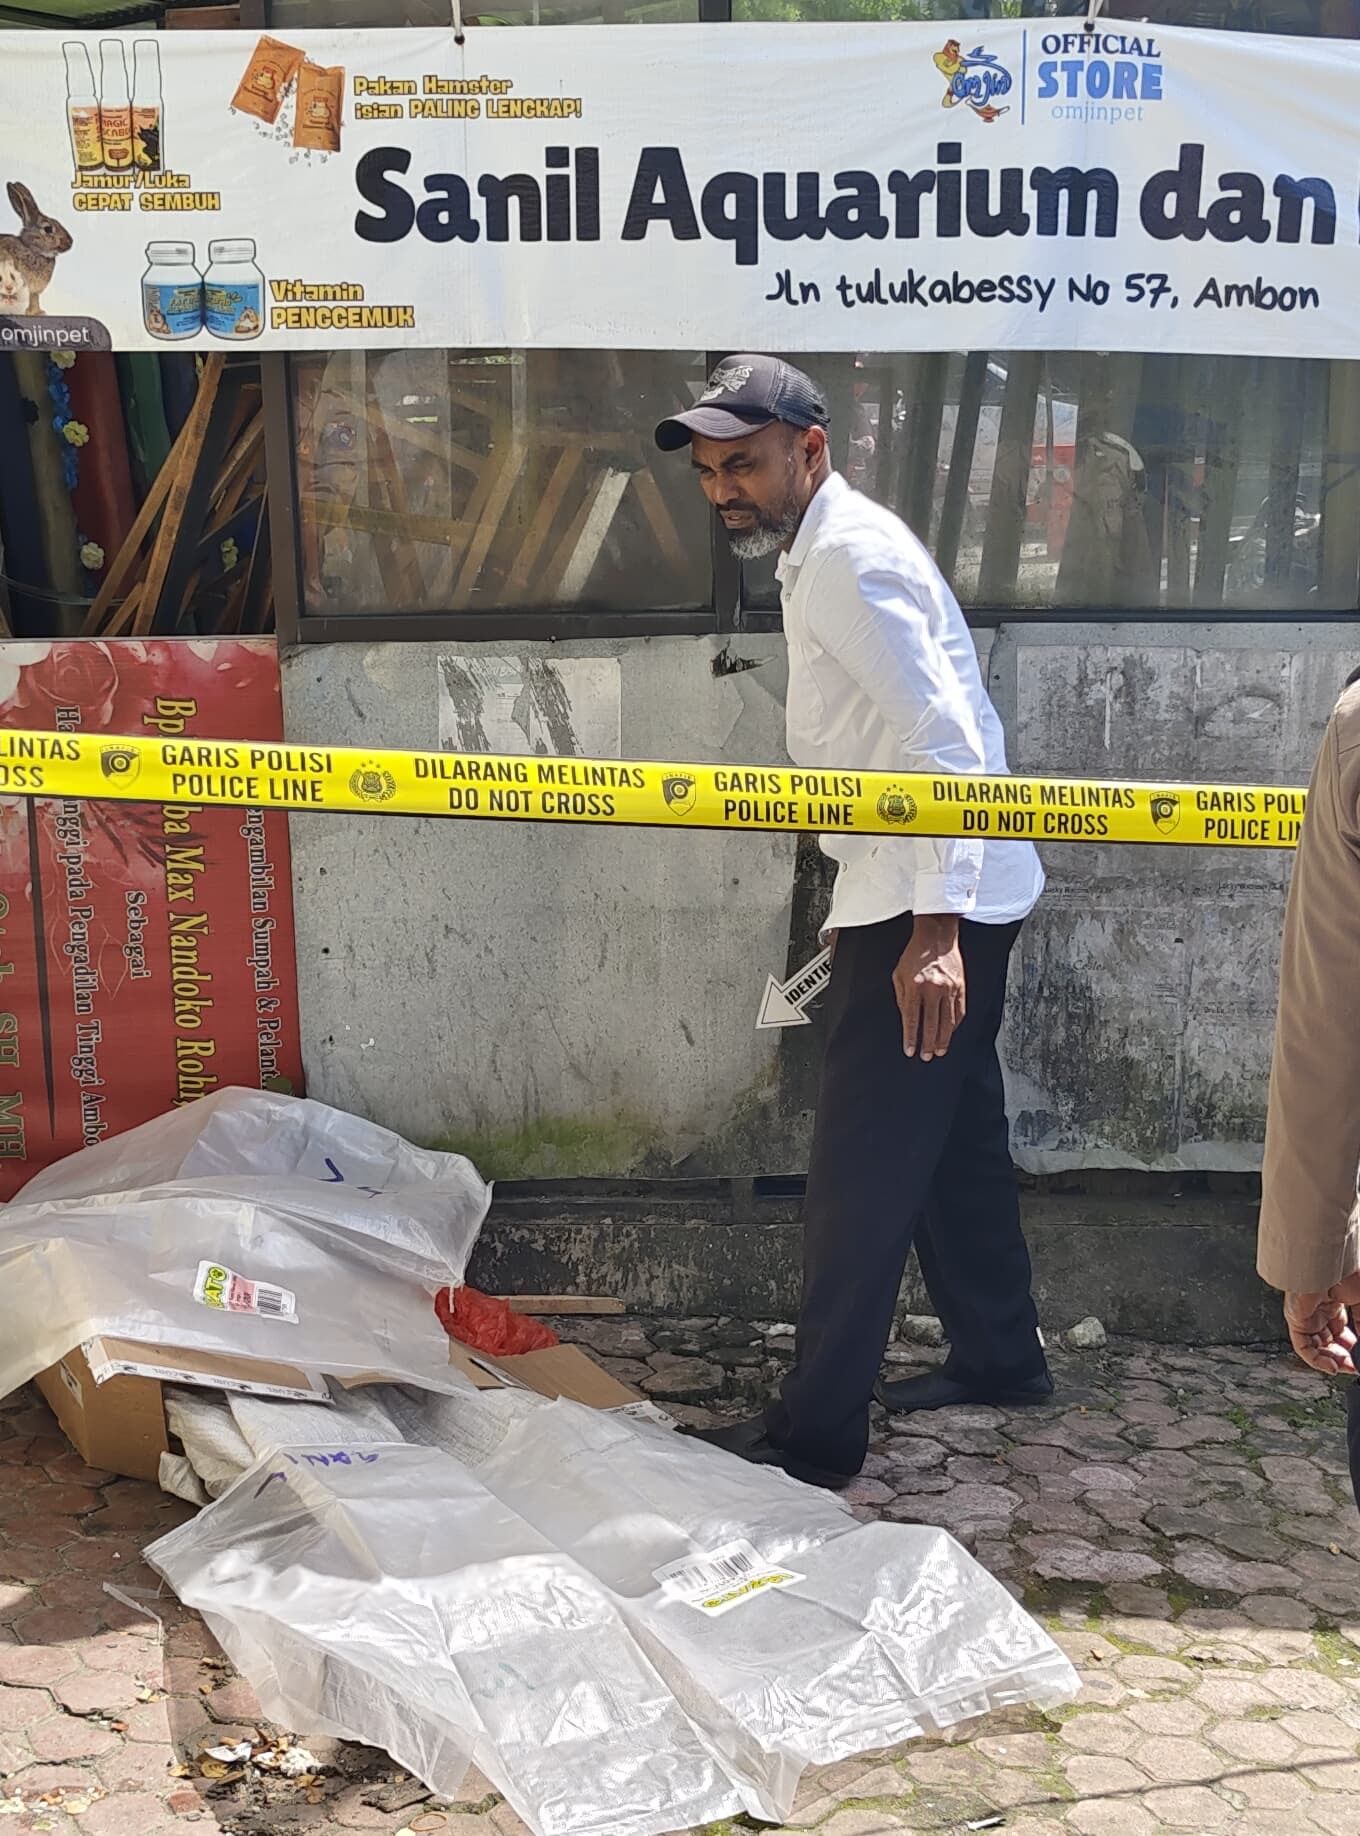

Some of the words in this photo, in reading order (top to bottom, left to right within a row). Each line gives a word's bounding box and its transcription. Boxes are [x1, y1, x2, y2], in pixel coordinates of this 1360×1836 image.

[1041, 33, 1161, 57] OFFICIAL
[354, 76, 417, 96] Pakan
[423, 75, 513, 95] Hamster
[1037, 60, 1163, 100] STORE
[355, 102, 403, 119] isian
[409, 98, 480, 118] PALING
[487, 98, 582, 118] LENGKAP!
[1051, 102, 1144, 124] omjinpet
[71, 169, 190, 188] Jamur/Luka
[73, 192, 133, 211] CEPAT
[139, 192, 221, 212] SEMBUH
[354, 145, 599, 243] Sanil
[621, 141, 1119, 265] Aquarium
[1140, 143, 1336, 246] dan
[269, 279, 364, 302] Vitamin
[765, 269, 821, 305] Jln
[1068, 274, 1109, 304] No
[1124, 273, 1178, 310] 57,
[1193, 275, 1320, 311] Ambon
[271, 306, 415, 329] PENGGEMUK
[1, 324, 90, 346] omjinpet
[143, 697, 198, 736] Bp
[161, 744, 240, 769] GARIS
[251, 748, 333, 774] POLISI
[414, 757, 528, 783] DILARANG
[537, 763, 645, 789] MELINTAS
[171, 773, 259, 799] POLICE
[269, 778, 324, 803] LINE
[713, 771, 781, 796] GARIS
[790, 775, 863, 799] POLISI
[932, 780, 1033, 805] DILARANG
[1040, 785, 1136, 810] MELINTAS
[448, 787, 482, 811] DO
[489, 789, 532, 813] NOT
[541, 792, 616, 817] CROSS
[723, 799, 800, 824] POLICE
[807, 803, 854, 826] LINE
[1196, 790, 1256, 813] GARIS
[1263, 793, 1306, 815] POLI
[962, 808, 991, 832] DO
[997, 810, 1037, 834] NOT
[1043, 812, 1108, 836] CROSS
[1204, 817, 1270, 841] POLICE
[1278, 820, 1301, 842] LI
[165, 844, 205, 902] Max
[240, 808, 275, 913] ngambilan
[57, 852, 93, 900] pada
[126, 890, 152, 979] Sebagai
[64, 905, 100, 1016] Pengadilan
[246, 917, 280, 992] Sumpah
[168, 911, 213, 1030] Nandoko
[784, 958, 833, 1005] IDENTIF
[256, 997, 280, 1012] &
[71, 1019, 105, 1086] Tinggi
[80, 1091, 108, 1148] Ambo
